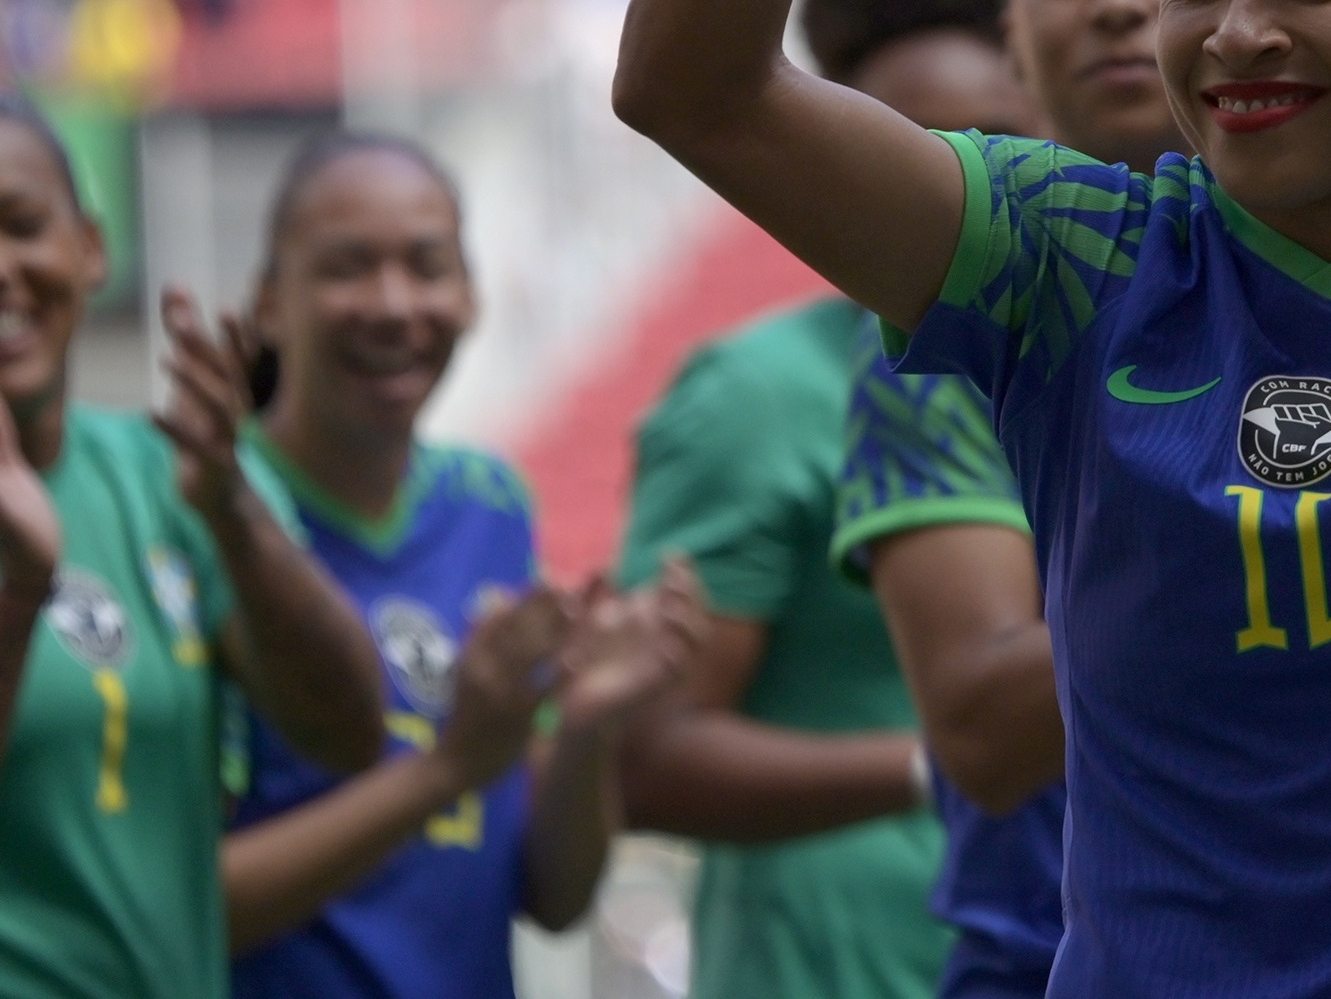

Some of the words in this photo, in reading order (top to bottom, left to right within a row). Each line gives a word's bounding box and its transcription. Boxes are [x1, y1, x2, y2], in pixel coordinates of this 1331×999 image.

[1261, 380, 1290, 393] COM
[1281, 443, 1307, 453] CBF
[1248, 453, 1270, 475] NÃO
[1276, 471, 1305, 482] TEM
